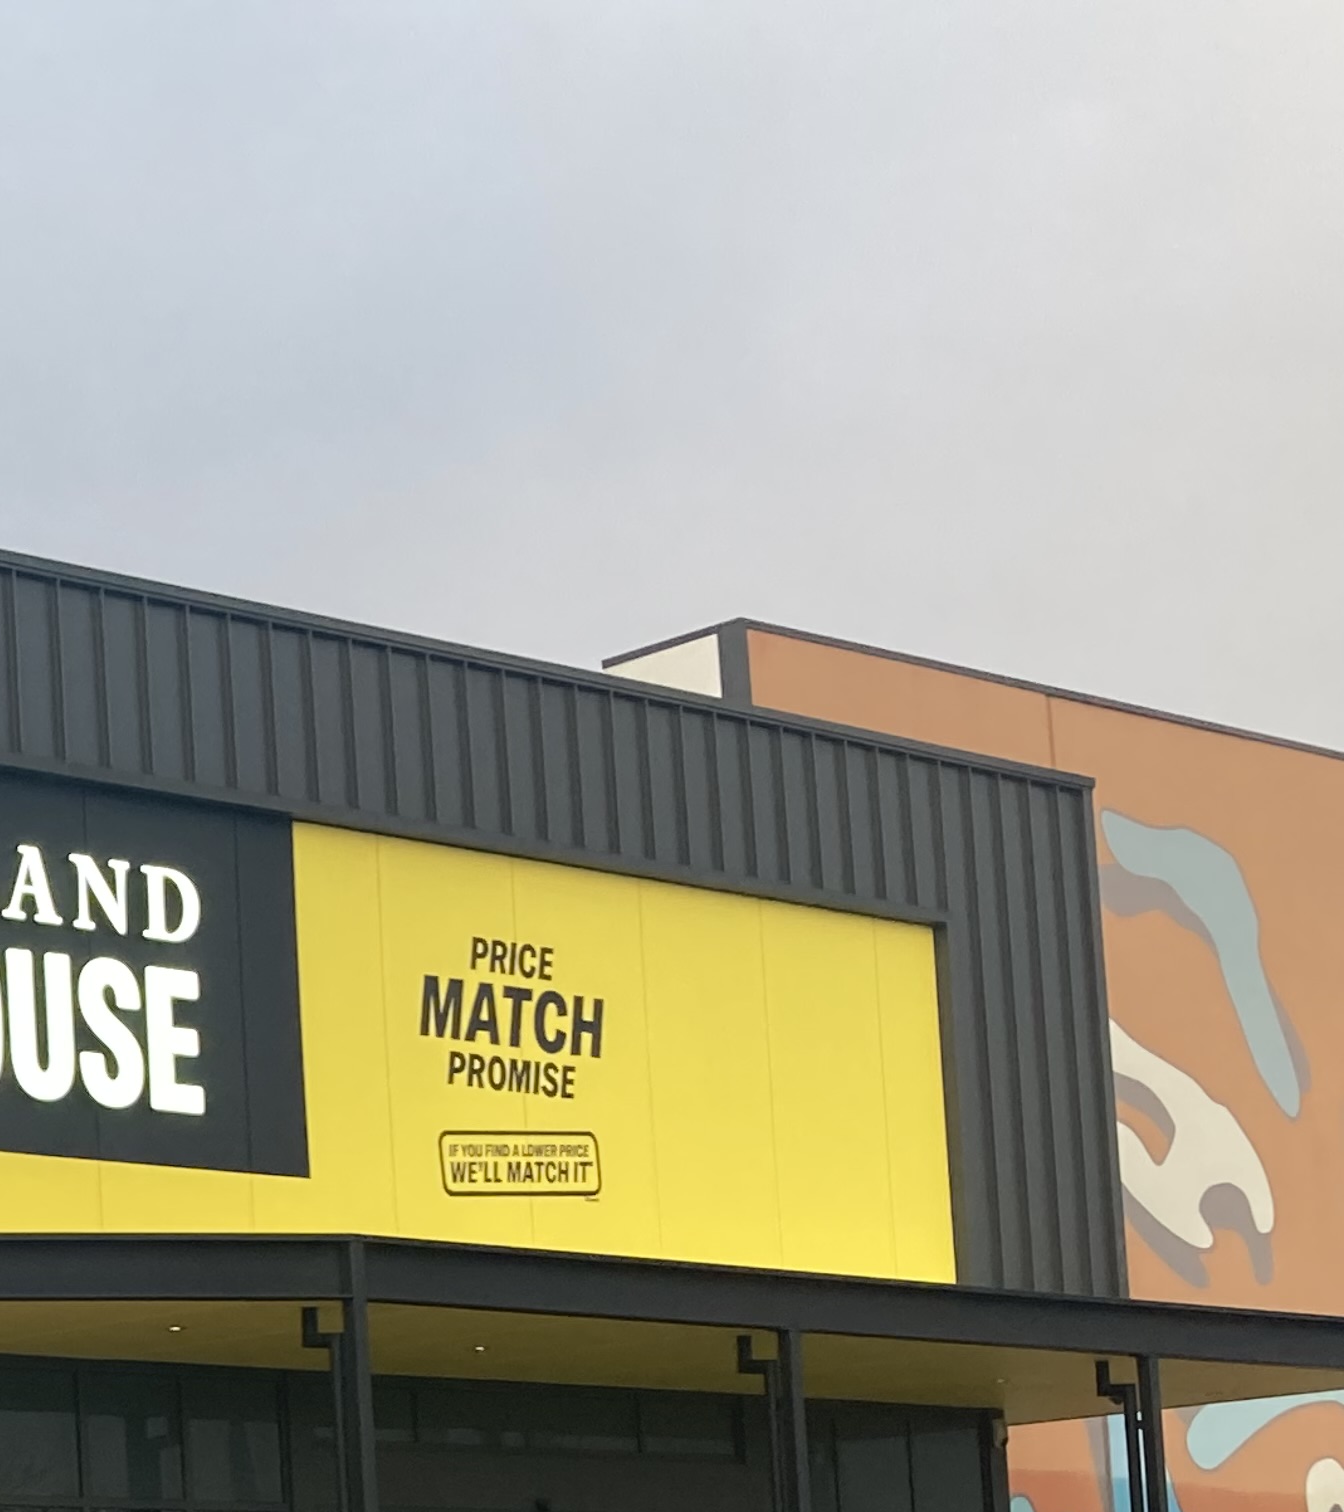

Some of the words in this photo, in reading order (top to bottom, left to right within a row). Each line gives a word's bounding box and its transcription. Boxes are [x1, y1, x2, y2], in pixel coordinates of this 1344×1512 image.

[470, 936, 554, 981] PRICE
[419, 974, 604, 1059] MATCH
[447, 1050, 576, 1099] PROMISE
[450, 1161, 503, 1183] WE'LL
[507, 1161, 569, 1184] MATCH
[573, 1161, 594, 1183] IT
[462, 1143, 483, 1158] YOU
[559, 1143, 590, 1158] PRICE
